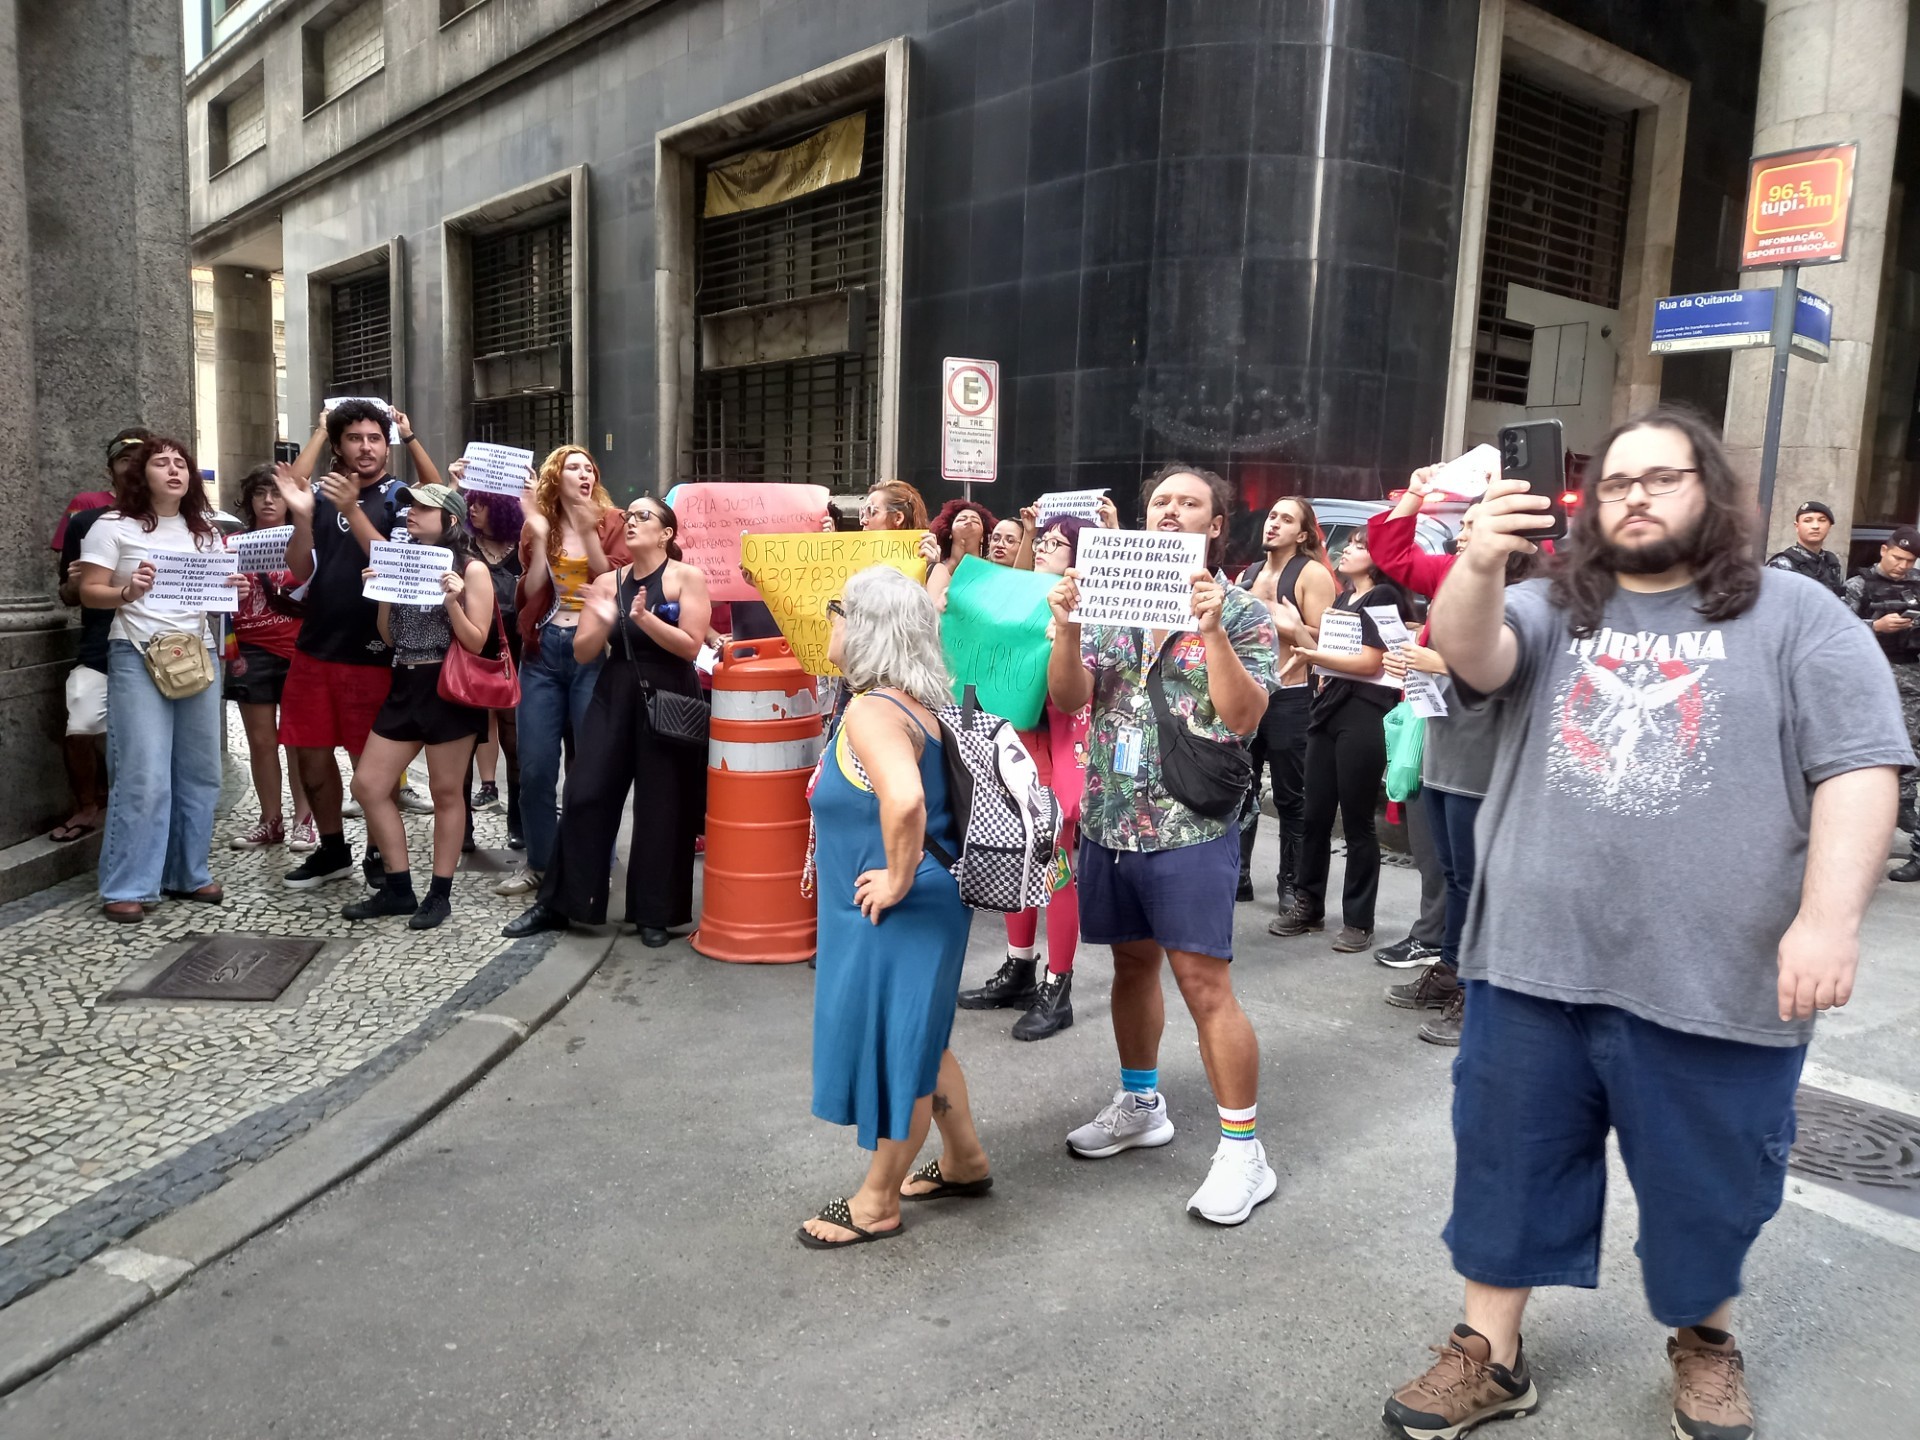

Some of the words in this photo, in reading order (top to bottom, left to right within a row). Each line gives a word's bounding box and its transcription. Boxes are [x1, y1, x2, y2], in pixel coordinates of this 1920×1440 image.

[1769, 180, 1812, 202] 96.5
[1759, 231, 1825, 247] INFORMAÇÃO,
[1747, 247, 1784, 259] ESPORTE
[1793, 241, 1837, 252] EMOÇÃO
[1659, 301, 1677, 310] Rua
[1694, 293, 1742, 307] Quitanda
[1655, 342, 1672, 352] 109
[963, 377, 981, 405] E
[685, 496, 717, 514] PELA
[724, 496, 766, 511] JUSTA
[685, 535, 734, 550] QUEREMOS
[1092, 535, 1121, 547] PAES
[1124, 537, 1155, 549] PELO
[1157, 539, 1185, 551] RIO,
[745, 541, 758, 563] O
[765, 540, 790, 563] RJ
[797, 540, 845, 563] QUER
[1082, 549, 1109, 559] LULA
[1112, 550, 1143, 561] PELO
[1145, 552, 1197, 564] BRASIL!
[1090, 566, 1120, 577] PAES
[1123, 568, 1154, 579] PELO
[1156, 570, 1182, 582] RIO,
[1080, 577, 1108, 588] LULA
[1111, 580, 1141, 590] PELO
[1144, 582, 1194, 594] BRASIL!
[1089, 595, 1120, 607] PAES
[1122, 598, 1153, 608] PELO
[1155, 600, 1181, 612] RIO,
[1078, 607, 1106, 619] LULA
[1109, 609, 1140, 621] PELO
[1142, 612, 1192, 625] BRASIL!
[1565, 627, 1728, 662] NIRVANA
